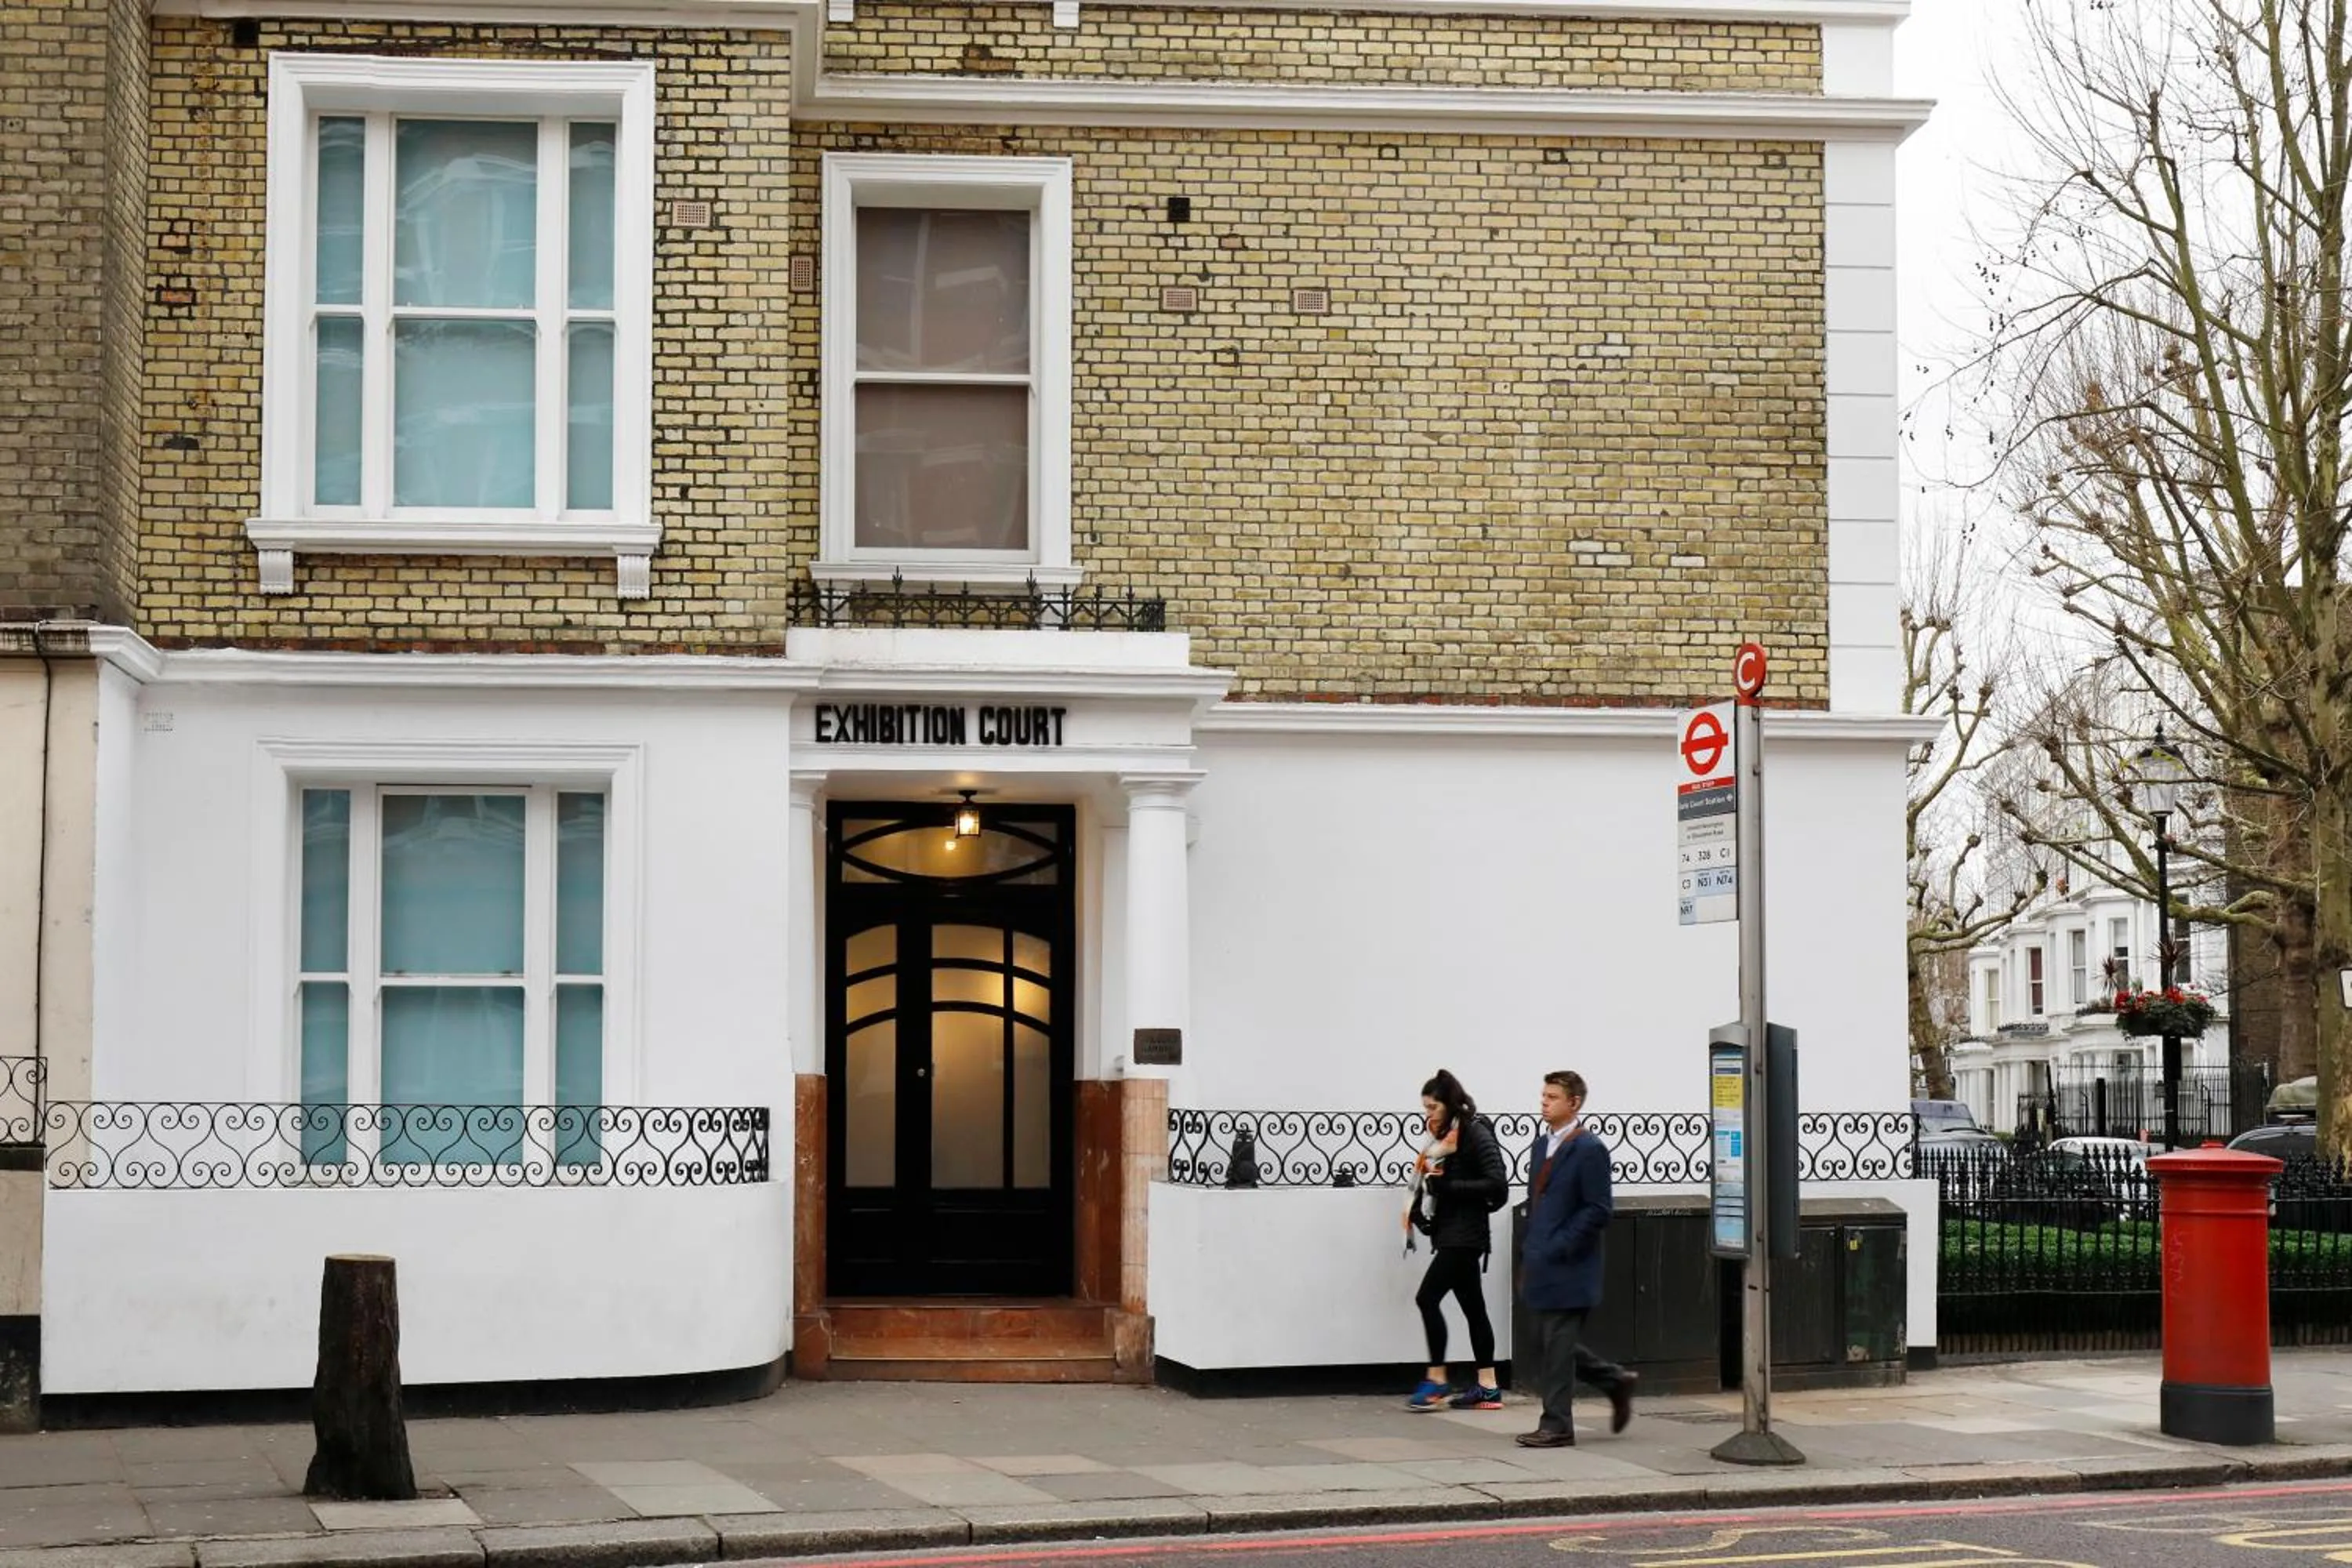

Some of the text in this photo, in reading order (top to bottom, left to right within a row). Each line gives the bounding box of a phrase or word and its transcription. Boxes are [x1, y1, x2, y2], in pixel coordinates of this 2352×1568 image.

[1737, 652, 1755, 691] C
[815, 702, 1067, 746] EXHIBITION COURT
